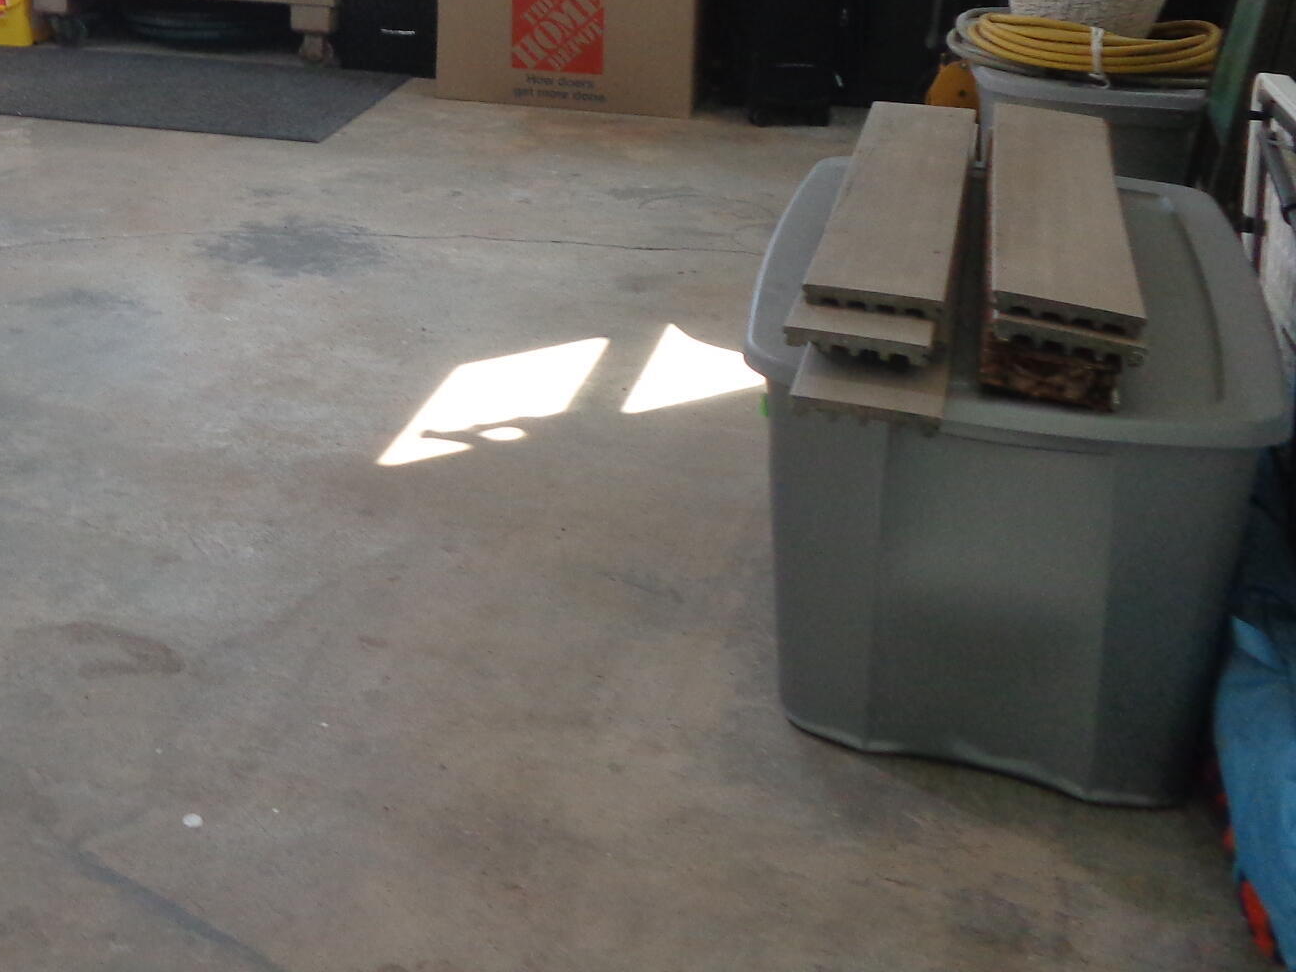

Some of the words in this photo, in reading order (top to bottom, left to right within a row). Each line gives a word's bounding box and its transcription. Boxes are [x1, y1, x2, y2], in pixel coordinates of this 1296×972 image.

[547, 17, 603, 70] DEPOT
[526, 73, 554, 85] How
[513, 87, 534, 99] get
[537, 88, 569, 100] more
